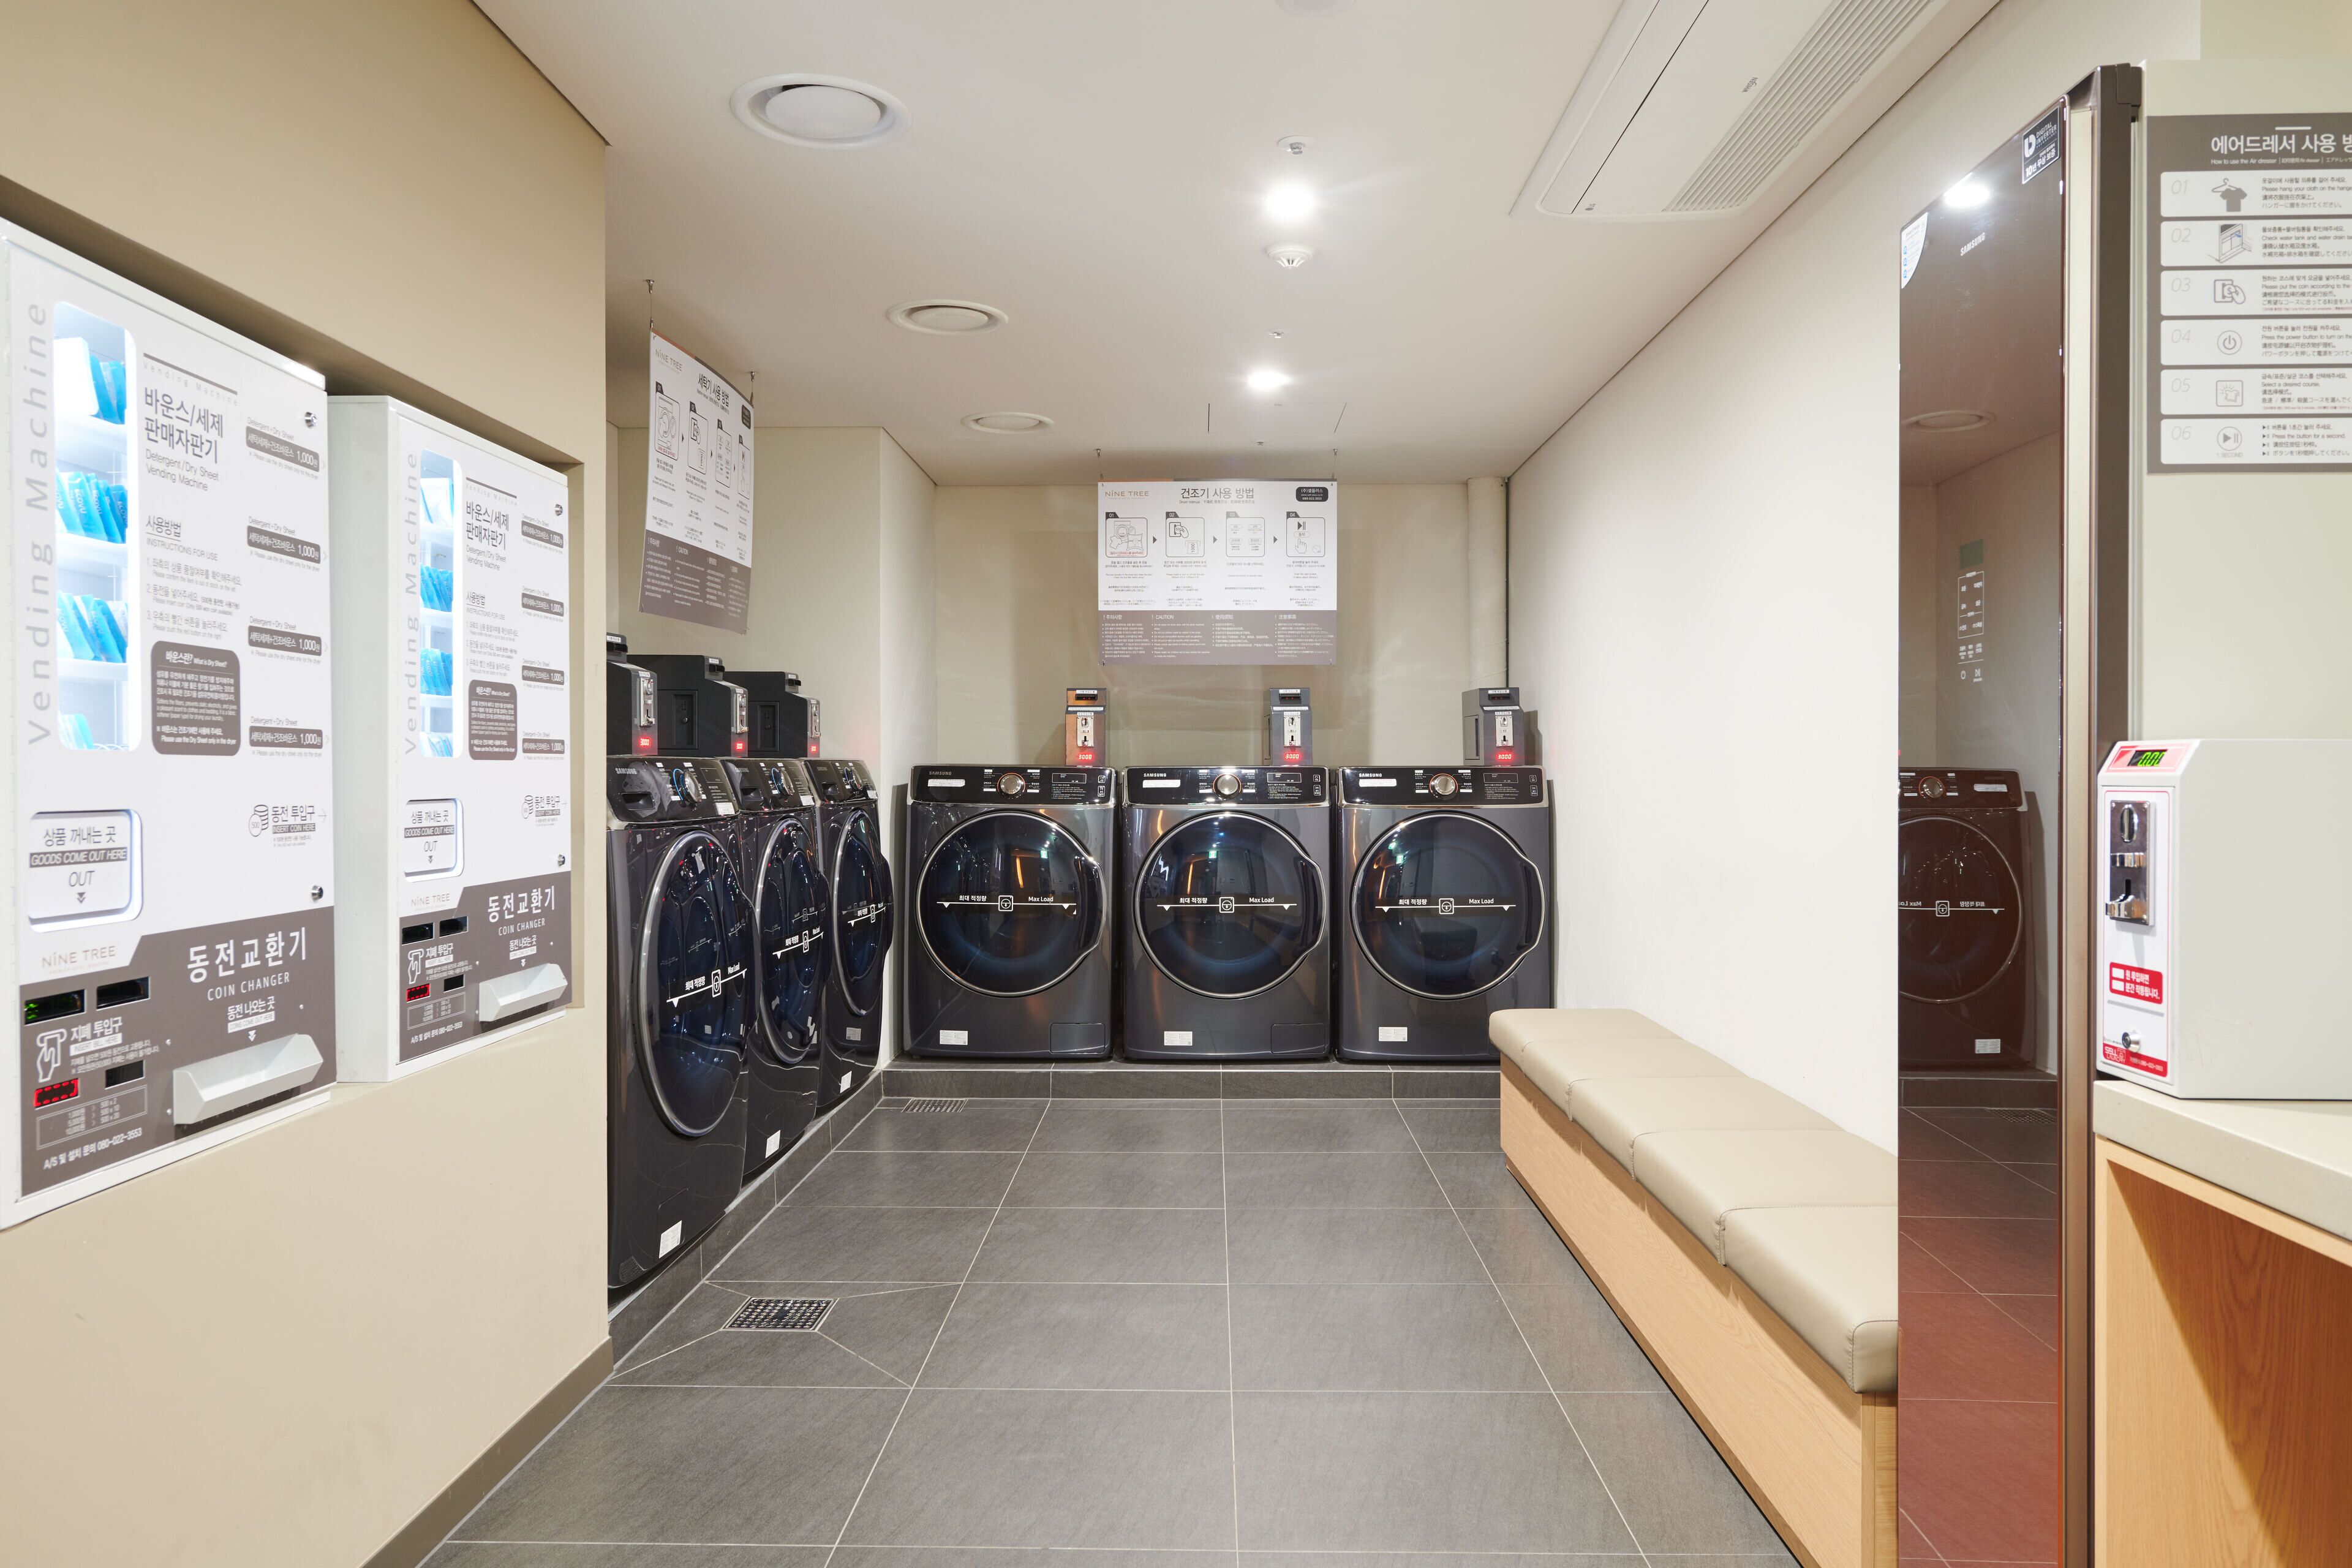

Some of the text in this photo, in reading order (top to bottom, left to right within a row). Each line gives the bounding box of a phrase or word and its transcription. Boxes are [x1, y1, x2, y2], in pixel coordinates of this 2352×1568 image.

[2036, 122, 2052, 138] DIGITAL
[2036, 124, 2057, 145] INVERTER
[2211, 134, 2337, 154] 에어드레서 사용
[2171, 180, 2188, 194] 01
[1960, 232, 1985, 257] SAMSUNG
[2171, 228, 2191, 243] 02
[2171, 329, 2191, 344] 04
[670, 358, 682, 372] TREE
[698, 373, 712, 395] 세탁기
[712, 383, 721, 401] 사용
[145, 386, 223, 439] 바운스/세제
[145, 417, 217, 465] 판매자판기
[297, 450, 318, 469] 1,000원
[146, 463, 208, 491] Vending Machine
[200, 466, 219, 481] Sheet
[1180, 488, 1254, 499] 건조기 사용 방법
[23, 304, 53, 745] Machine Vending
[466, 501, 509, 532] 바운스/세제
[146, 515, 182, 538] 사용방법
[466, 522, 506, 551] 판매자판기
[146, 538, 218, 561] INSTRUCTIONS FOR USE
[298, 544, 319, 560] 1,000원
[404, 454, 419, 755] Machine Vending
[299, 638, 320, 652] 1,000원
[300, 734, 321, 745] 1,000원
[271, 804, 315, 823] 동전 투입구
[410, 812, 423, 825] 상품
[43, 826, 116, 847] 상품 꺼내는 곳
[423, 840, 438, 852] OUT
[31, 848, 127, 866] GOODS COME OUT HERE
[68, 870, 96, 887] OUT
[432, 892, 451, 903] TREE
[488, 885, 556, 924] 동전교환기
[499, 918, 546, 936] COIN CHANGER
[83, 945, 116, 961] TREE
[187, 927, 306, 983] 동전교환기
[2125, 969, 2131, 981] 원
[207, 971, 290, 1001] COIN CHANGER
[227, 995, 276, 1021] 동전 나오는 곳
[70, 1016, 123, 1042] 지폐 투입구
[43, 1157, 58, 1170] A/S
[97, 1127, 143, 1152] 080-022-3553
